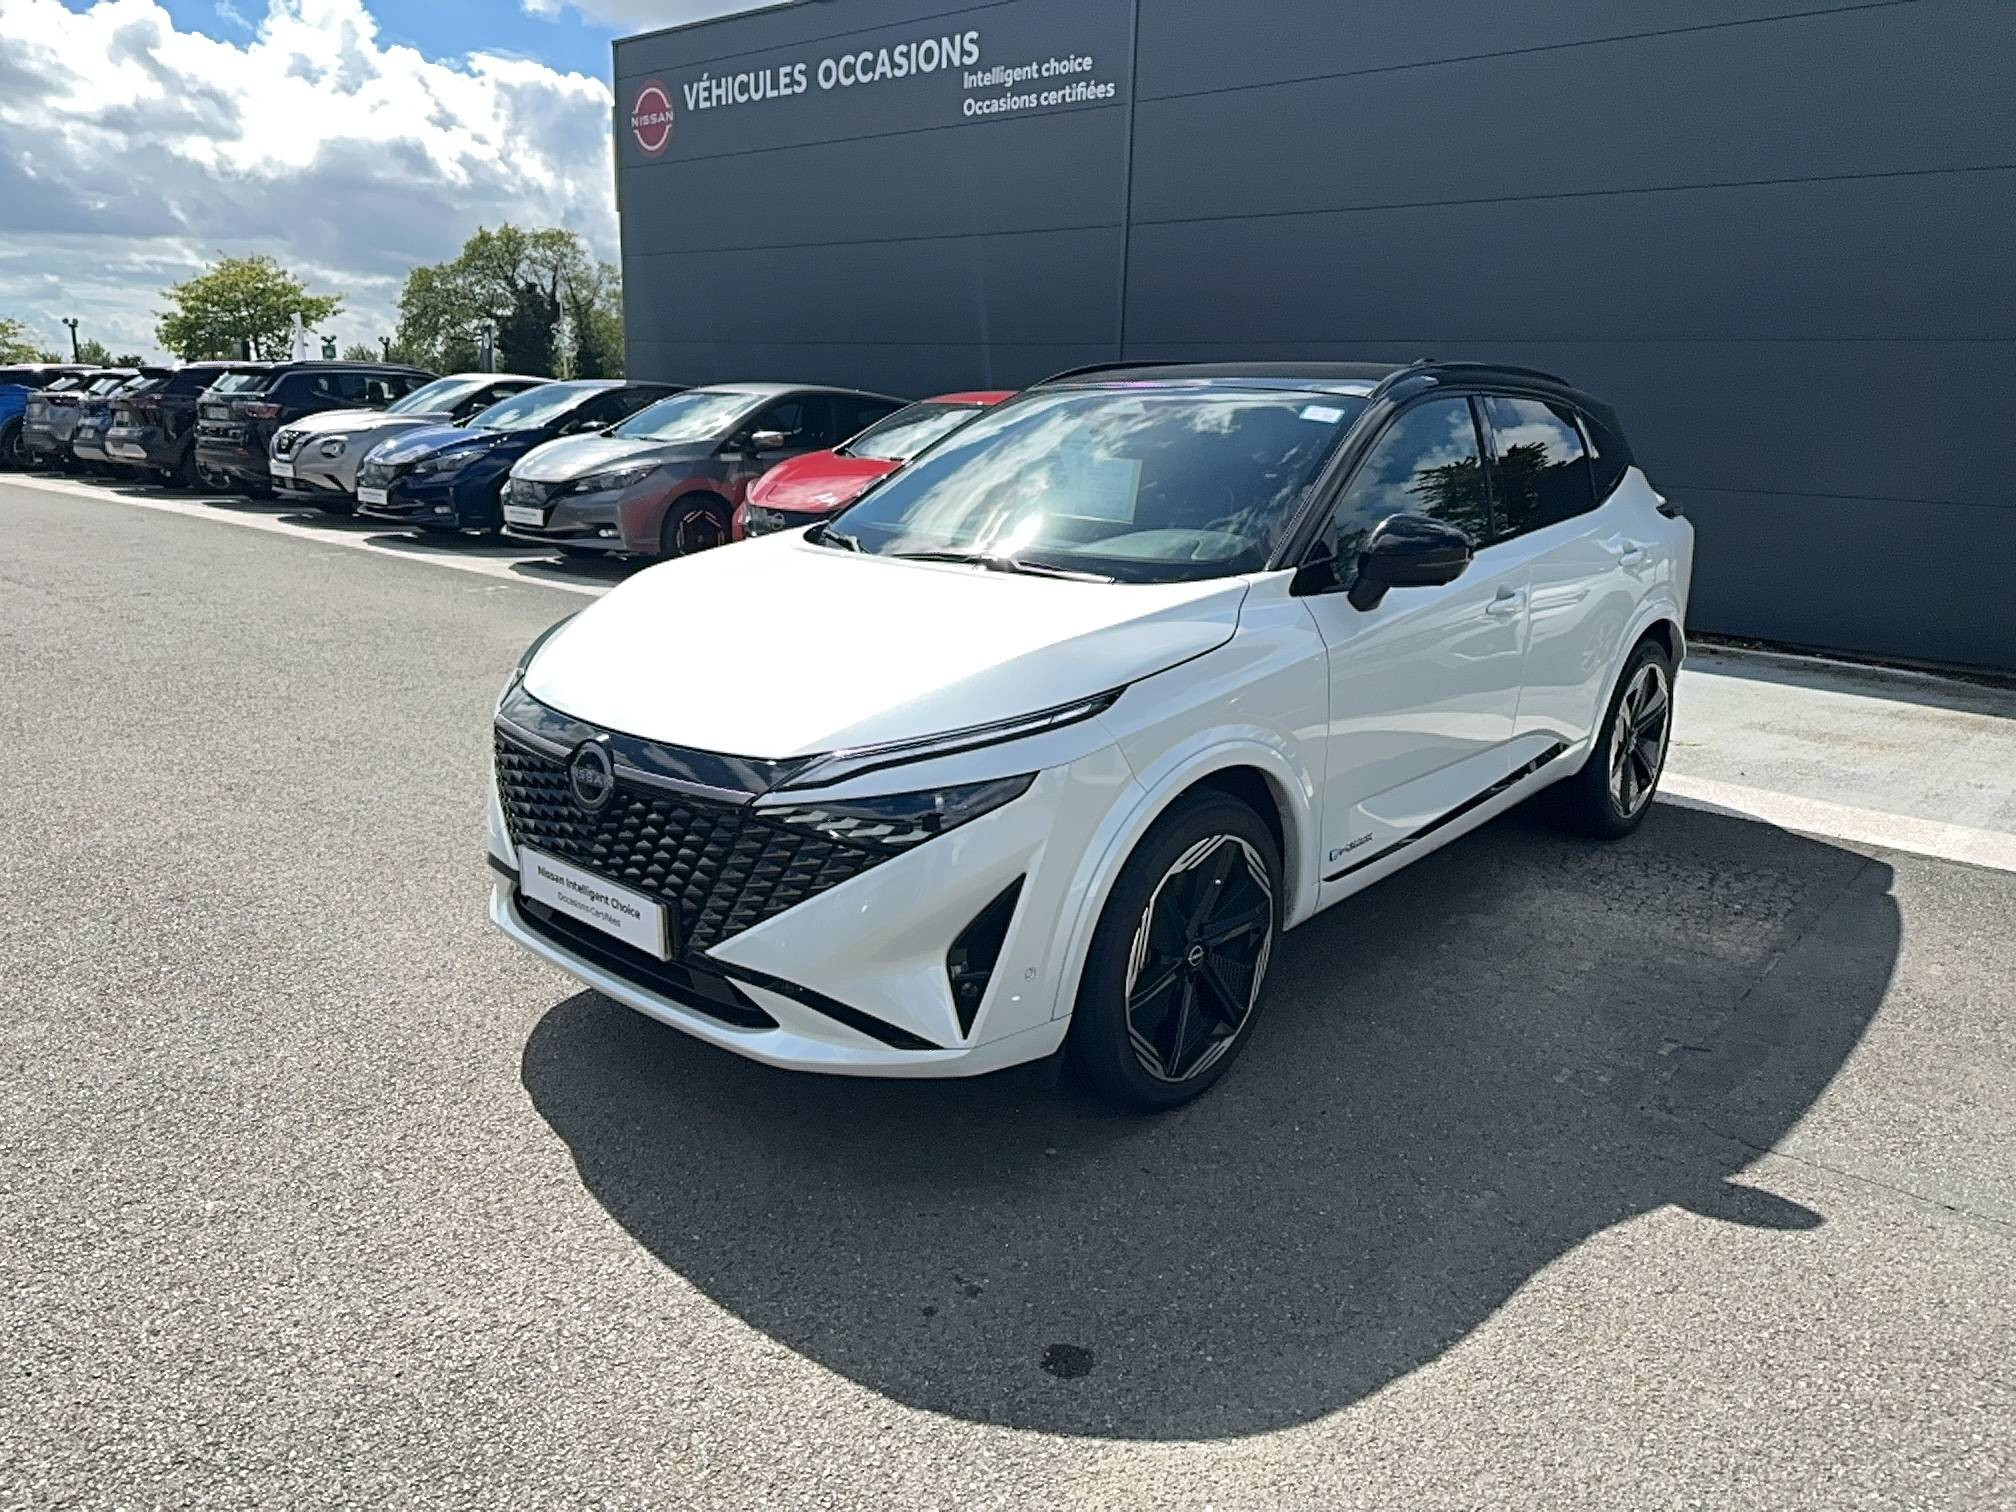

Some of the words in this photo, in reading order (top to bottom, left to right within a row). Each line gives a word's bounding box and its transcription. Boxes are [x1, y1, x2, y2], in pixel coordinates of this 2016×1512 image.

[683, 62, 808, 111] VÉHICULES
[817, 30, 980, 90] OCCASIONS
[963, 61, 1039, 89] Intelligent
[1041, 54, 1093, 77] choice
[963, 92, 1037, 116] Occasions
[1040, 80, 1115, 106] certifiées
[631, 111, 674, 127] NISSAN
[537, 865, 565, 886] Nissan
[565, 878, 610, 906] Intelligent
[611, 898, 641, 920] Choice
